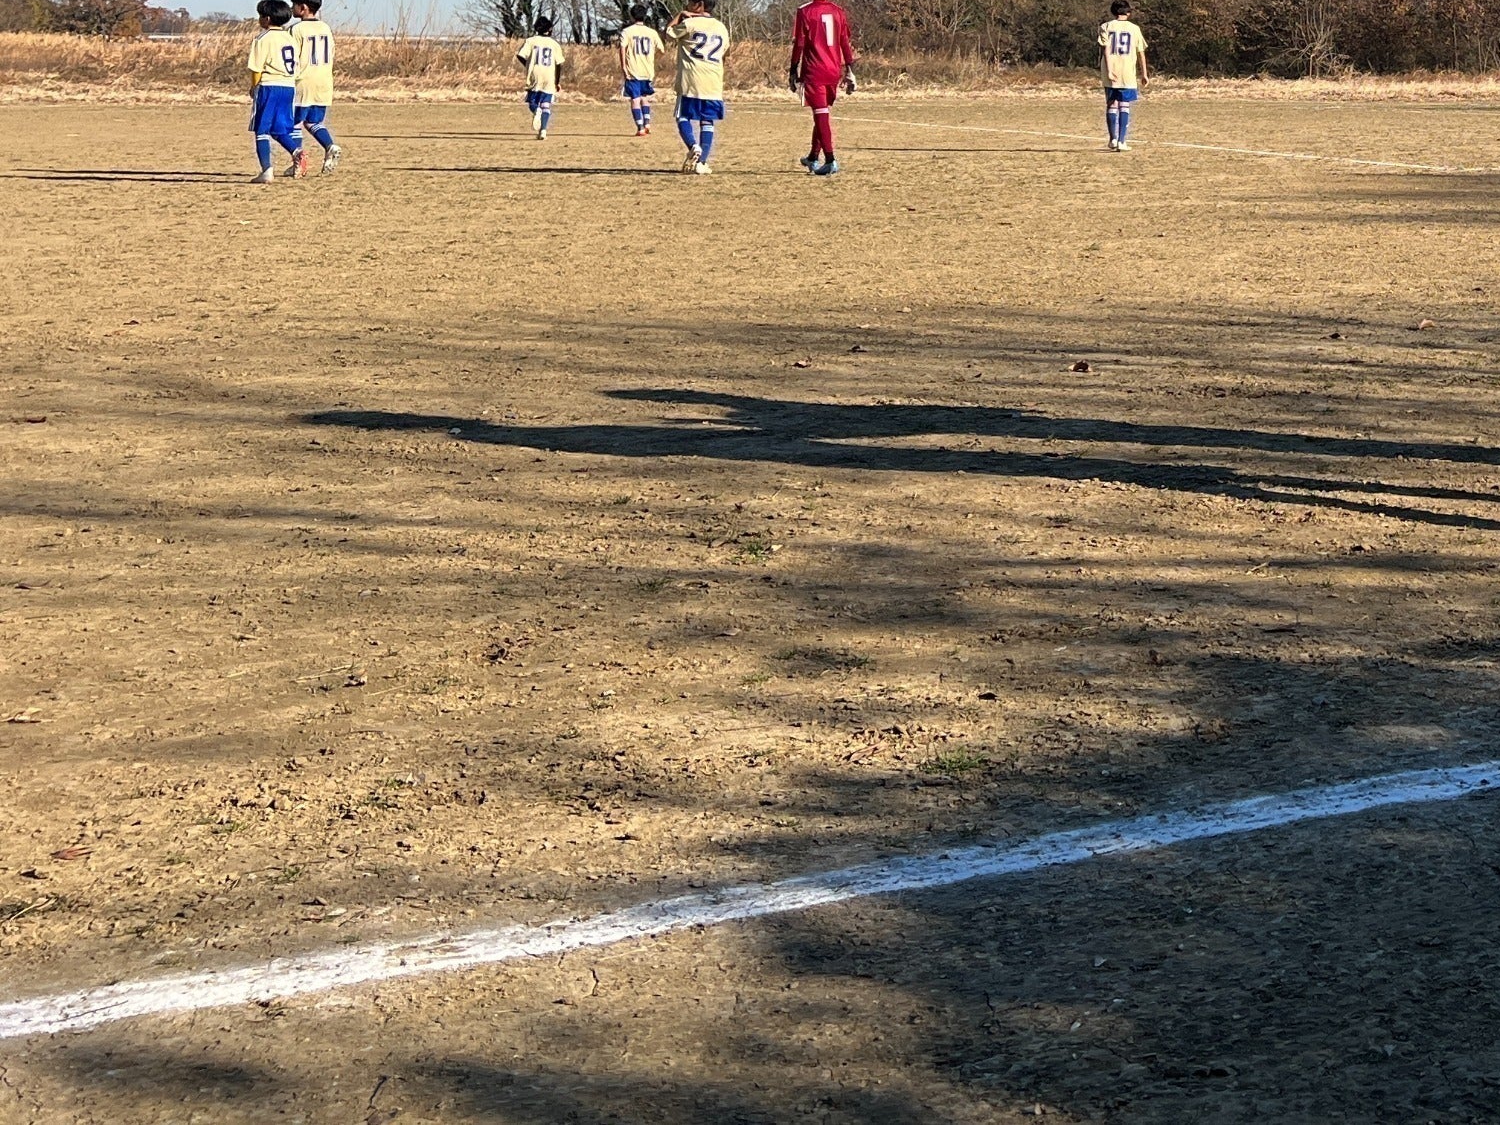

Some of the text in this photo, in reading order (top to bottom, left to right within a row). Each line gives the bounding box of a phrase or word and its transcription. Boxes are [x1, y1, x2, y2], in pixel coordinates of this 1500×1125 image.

[821, 13, 835, 47] 1
[1108, 31, 1131, 55] 19
[307, 35, 329, 65] 11
[533, 45, 552, 67] 18
[632, 35, 651, 55] 10
[690, 32, 723, 63] 22
